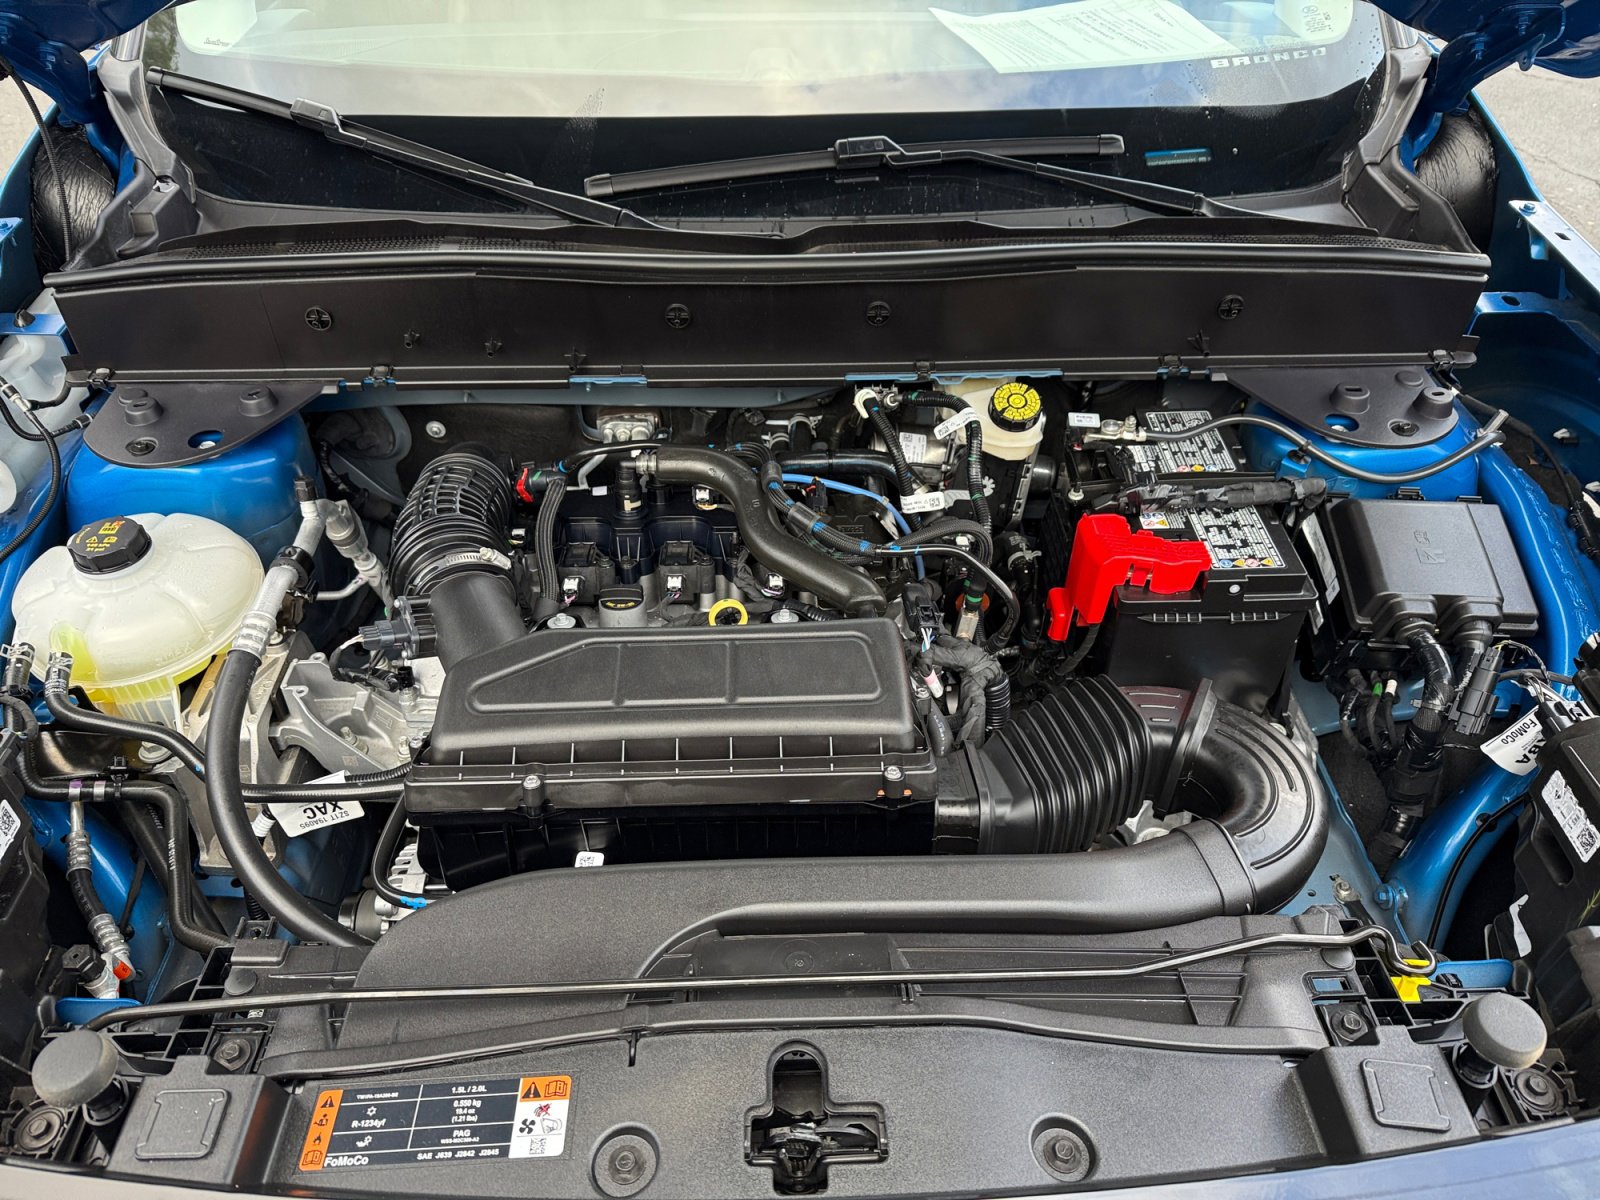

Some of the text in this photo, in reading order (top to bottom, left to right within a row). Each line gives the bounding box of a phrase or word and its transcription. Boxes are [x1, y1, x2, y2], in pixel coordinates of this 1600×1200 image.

[1210, 47, 1326, 69] BRONCO
[1501, 718, 1538, 745] FoMoCo
[303, 800, 344, 820] XAC
[472, 1099, 482, 1109] kg
[351, 1119, 387, 1129] R-1234yf
[452, 1129, 471, 1138] PAG
[323, 1155, 369, 1168] FoMoCo
[416, 1152, 433, 1160] SAE
